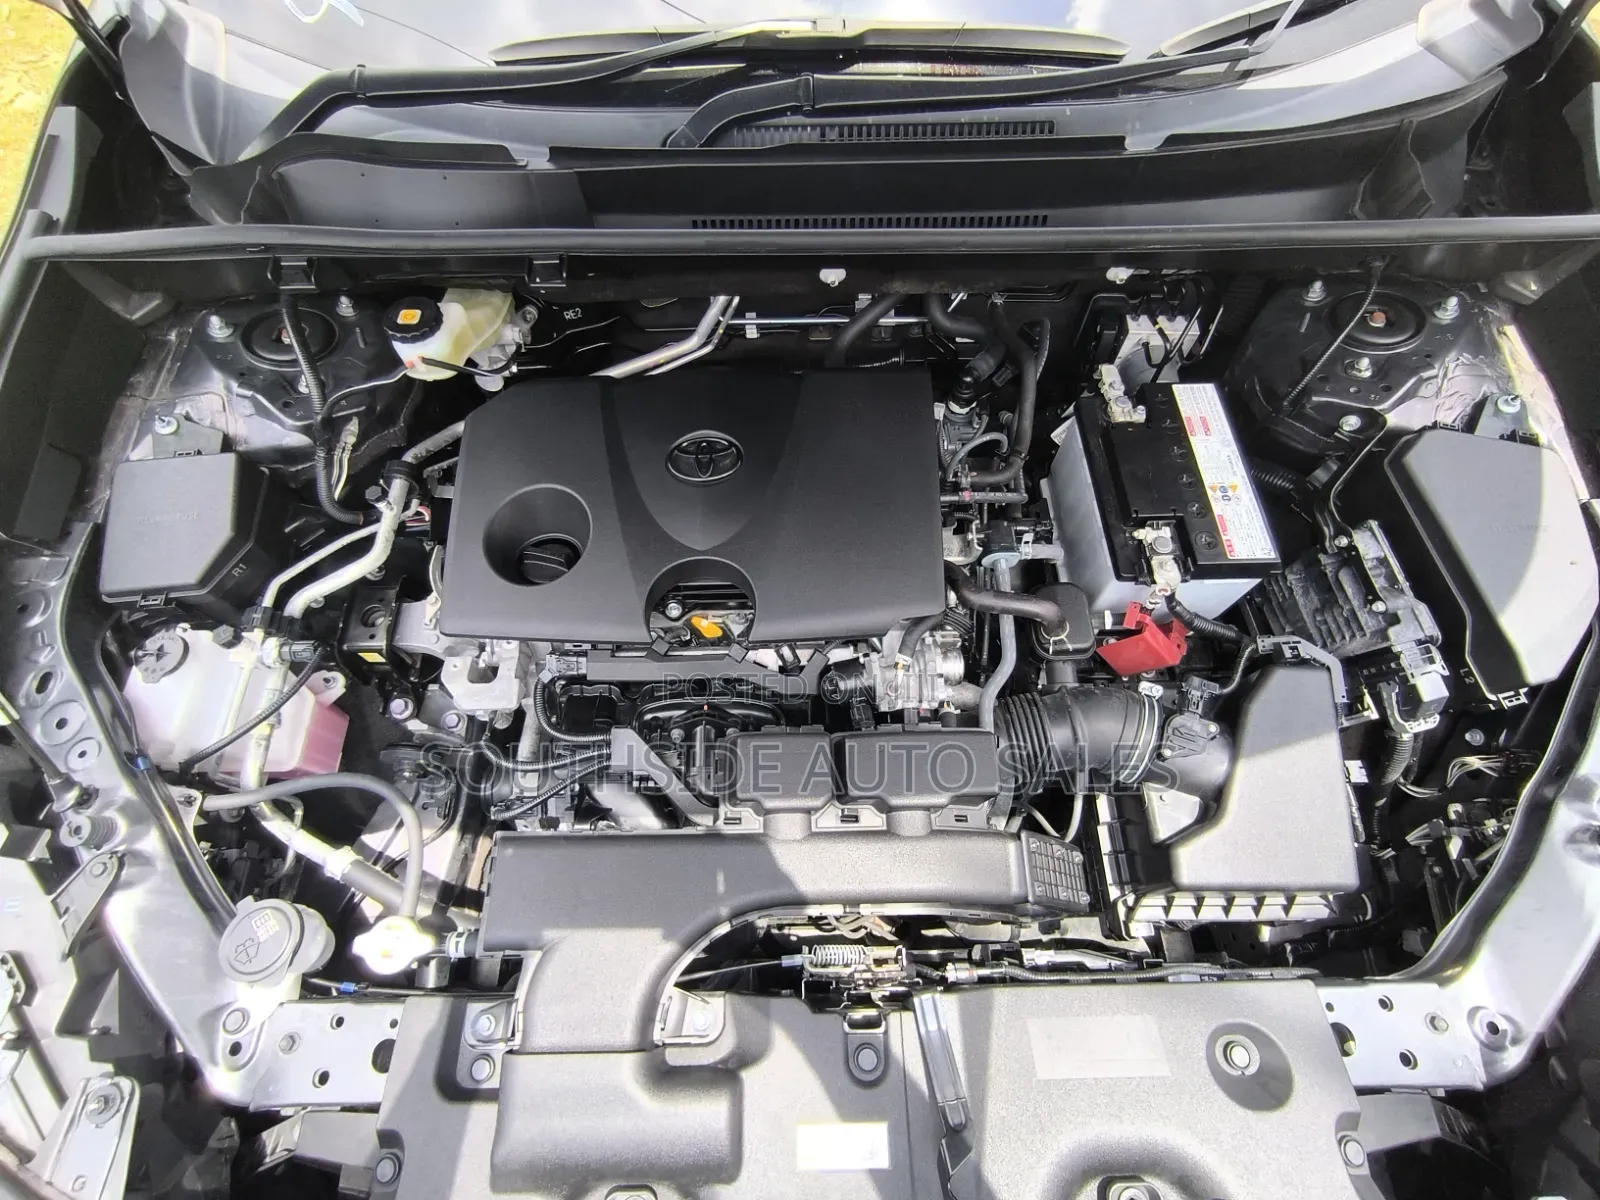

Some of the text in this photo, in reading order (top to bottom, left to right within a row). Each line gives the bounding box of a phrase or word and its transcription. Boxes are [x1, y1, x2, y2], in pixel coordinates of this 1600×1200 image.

[563, 307, 583, 321] RE2
[231, 563, 247, 577] R1
[1459, 667, 1475, 685] L2
